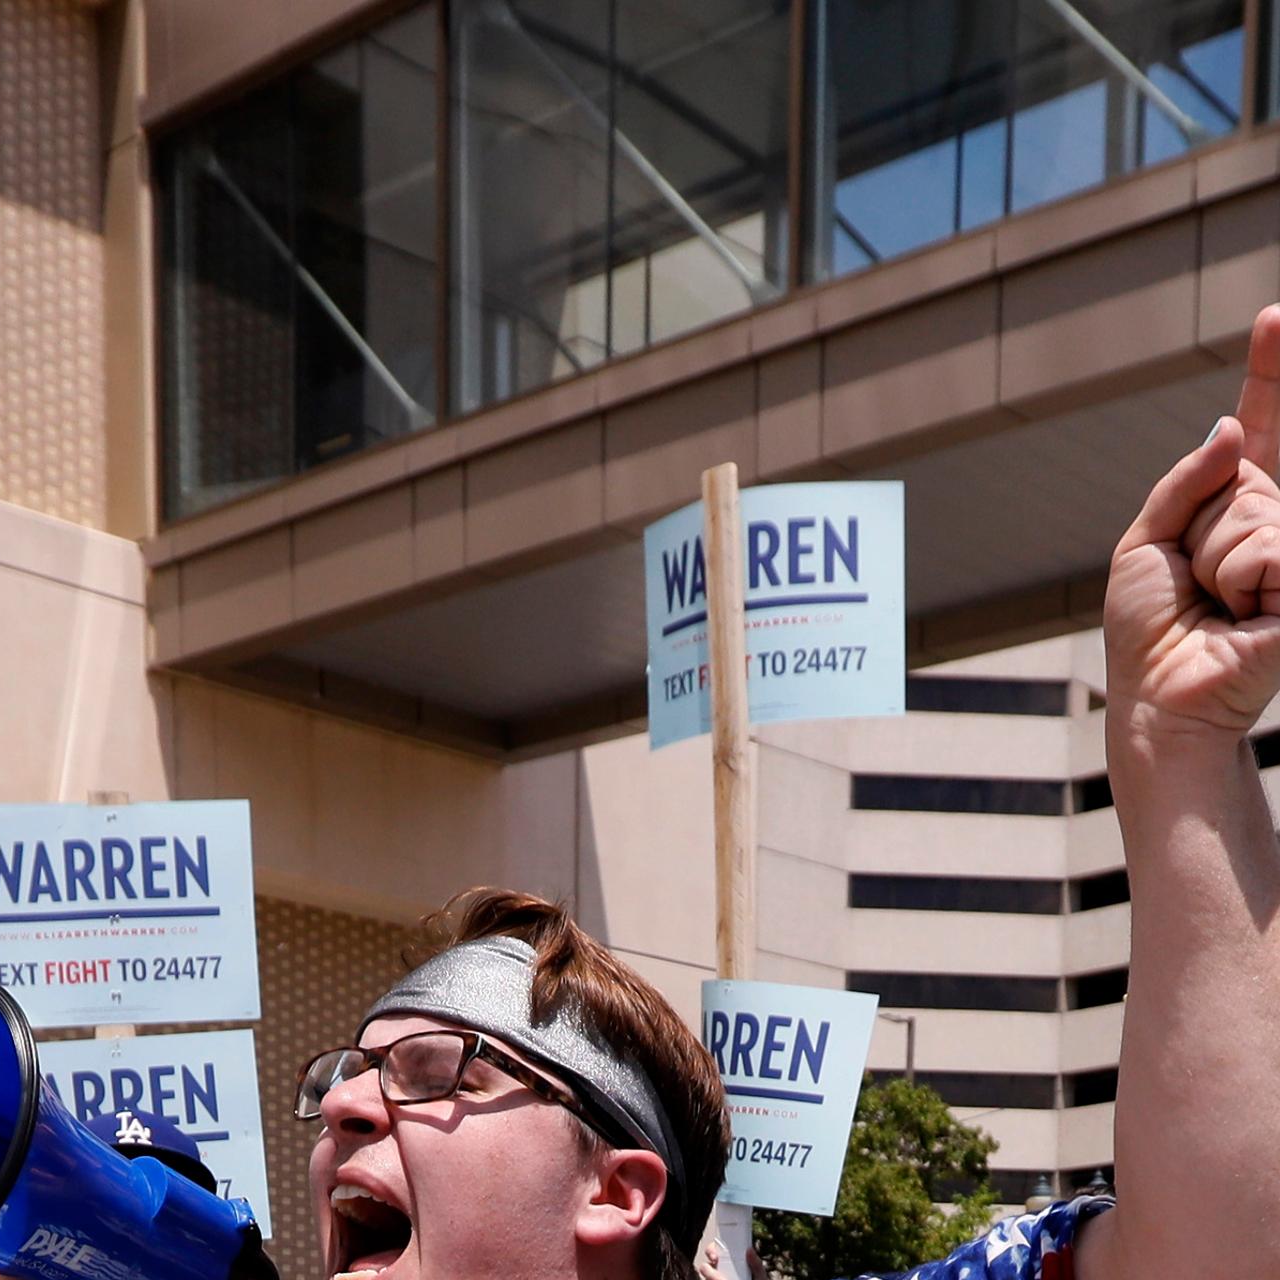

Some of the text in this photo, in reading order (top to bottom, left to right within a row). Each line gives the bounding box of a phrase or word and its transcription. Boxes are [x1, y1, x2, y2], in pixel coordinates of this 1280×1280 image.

[662, 515, 859, 614] WAREN
[664, 667, 695, 702] TEXT
[758, 651, 787, 678] TO
[793, 646, 868, 674] 24477
[44, 959, 112, 985] FIGHT
[117, 958, 147, 982] TO
[152, 955, 222, 981] 24477
[704, 1011, 831, 1084] RREN
[46, 1062, 219, 1127] RREN
[750, 1138, 813, 1168] 24477
